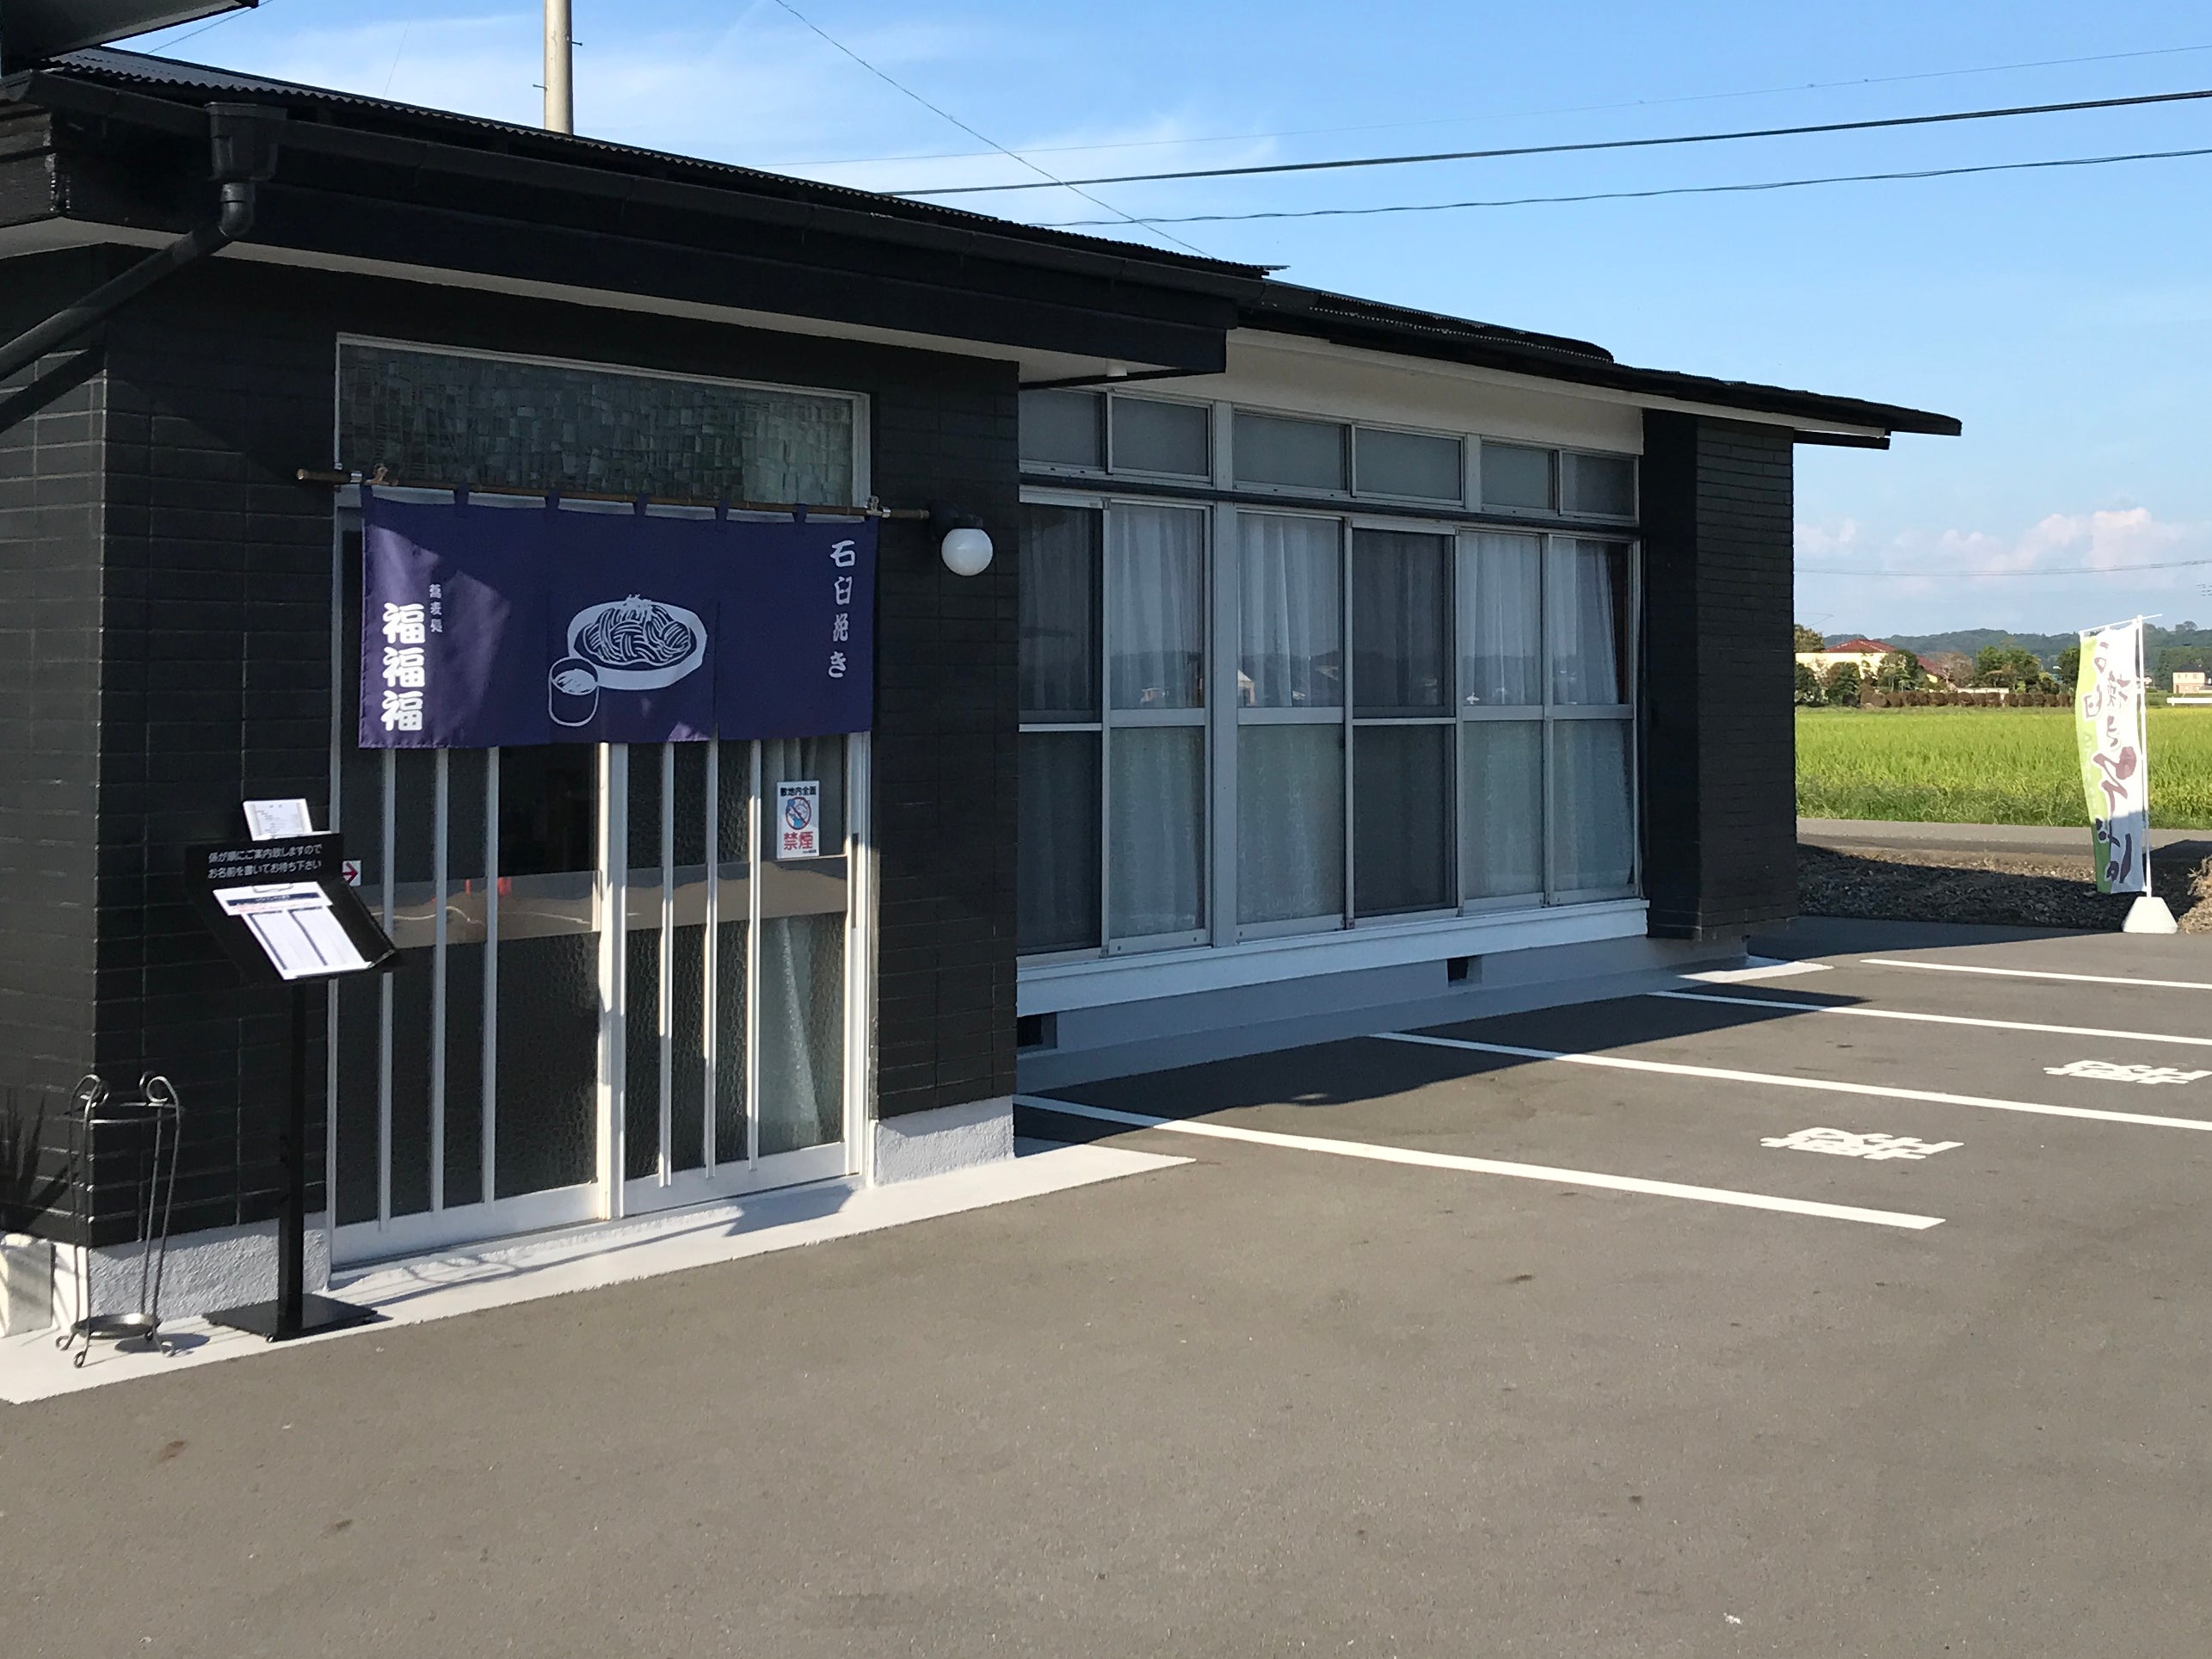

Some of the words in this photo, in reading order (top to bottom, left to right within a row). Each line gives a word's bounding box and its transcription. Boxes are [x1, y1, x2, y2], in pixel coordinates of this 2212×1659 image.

[428, 583, 443, 633] 蕎麦処
[828, 540, 857, 679] 石臼挽き
[381, 601, 427, 732] 福福福
[780, 786, 816, 797] 敷地内全面
[784, 831, 814, 850] 禁煙
